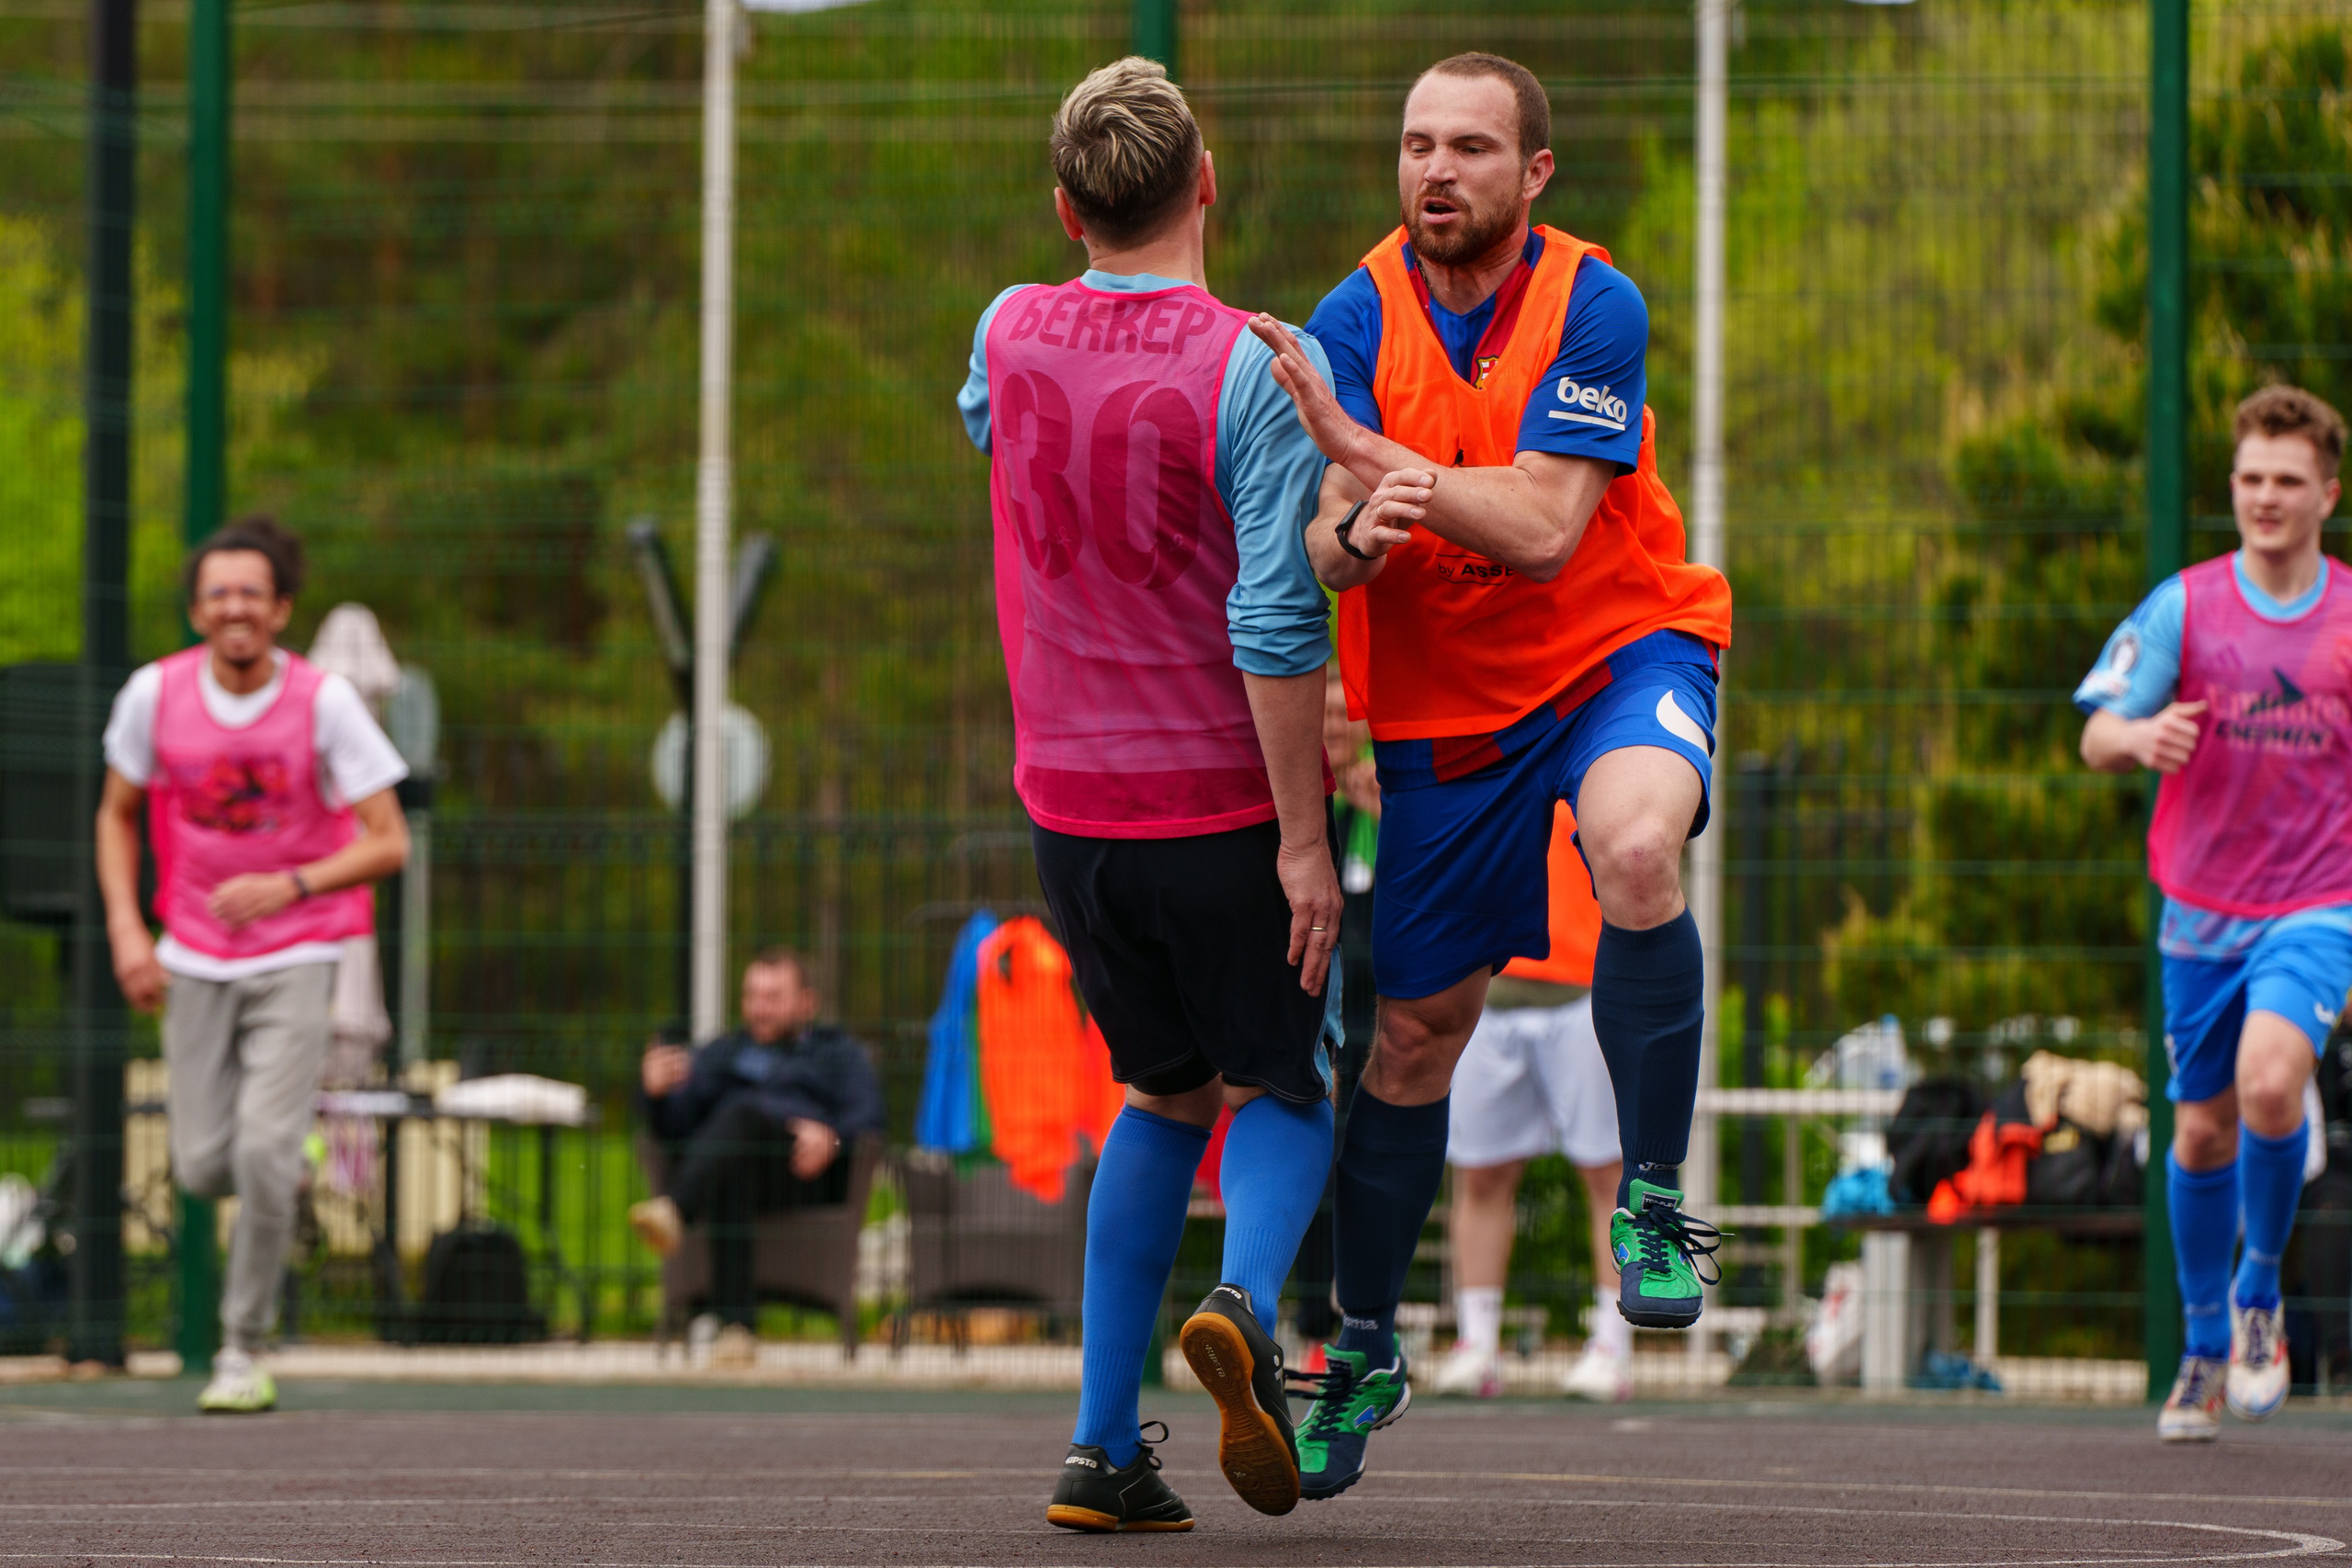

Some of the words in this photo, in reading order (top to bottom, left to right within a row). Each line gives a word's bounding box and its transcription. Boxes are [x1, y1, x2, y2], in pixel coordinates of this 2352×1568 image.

[1556, 377, 1627, 423] beko
[1000, 369, 1201, 590] 30
[1437, 562, 1455, 578] by
